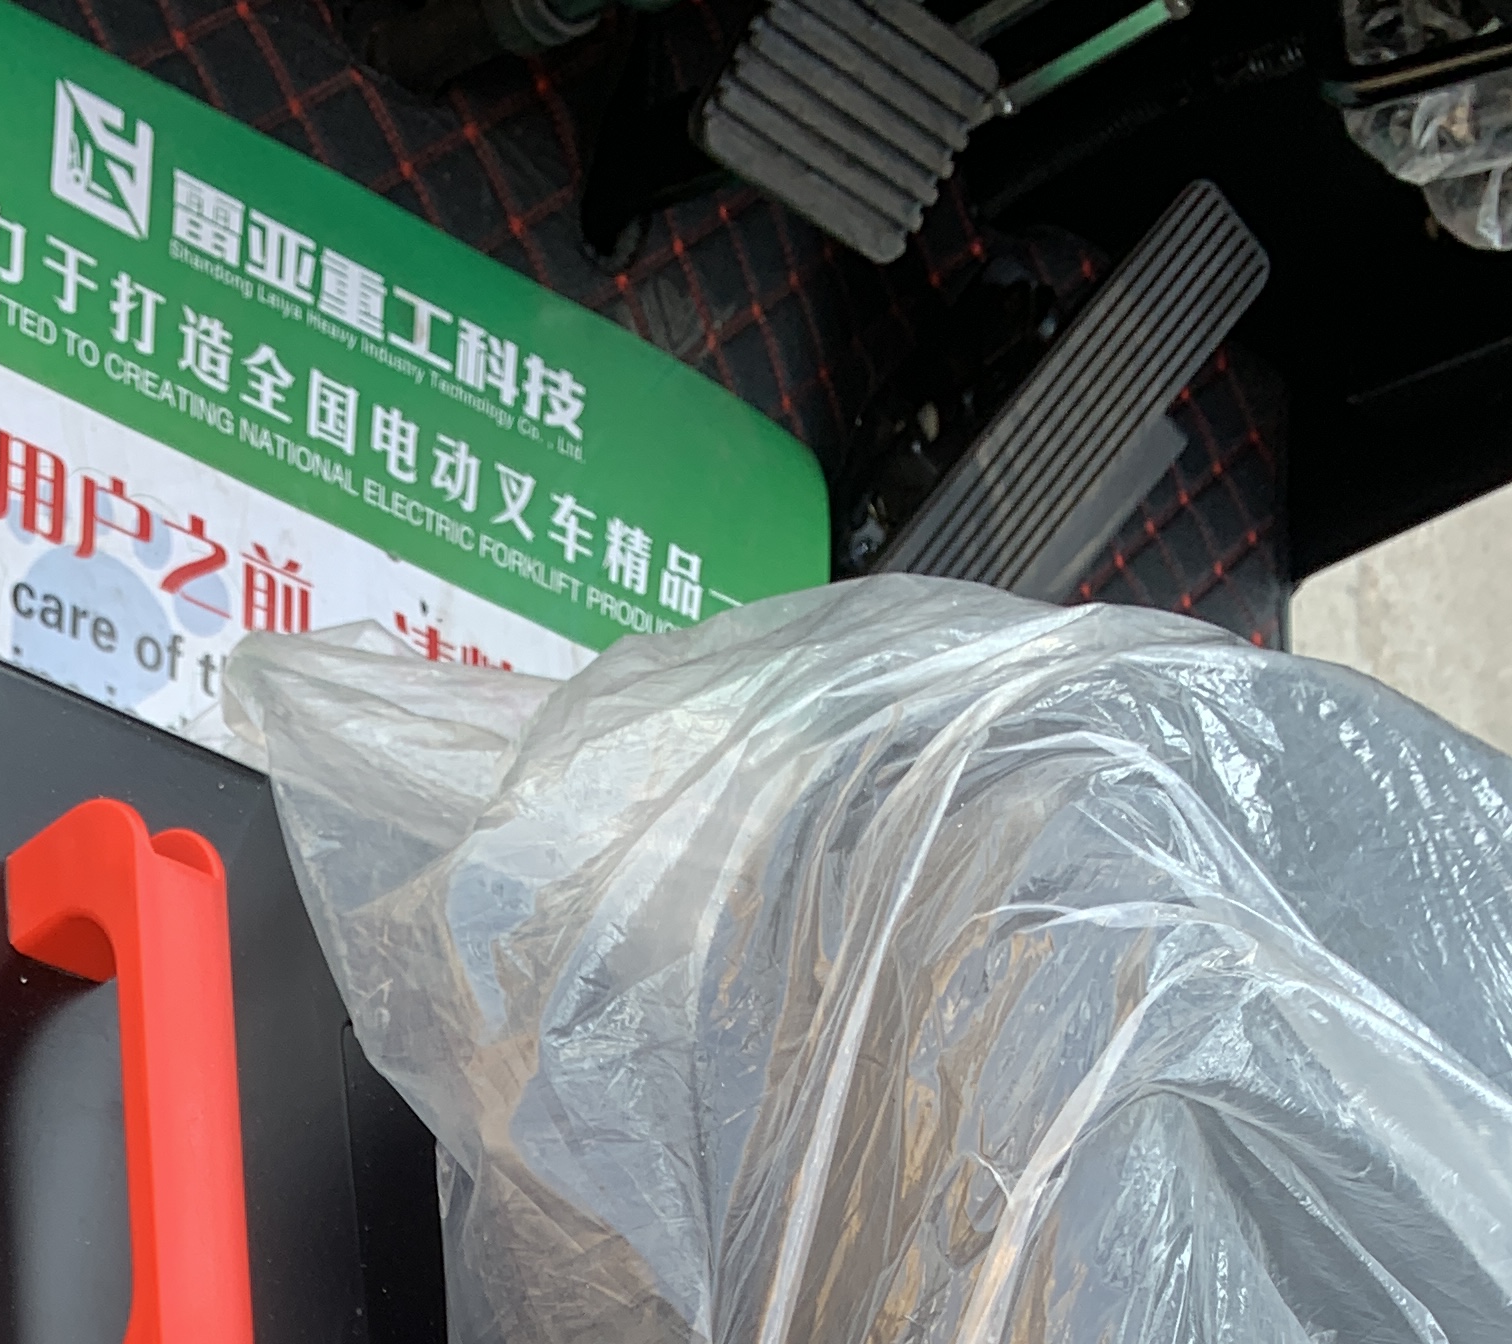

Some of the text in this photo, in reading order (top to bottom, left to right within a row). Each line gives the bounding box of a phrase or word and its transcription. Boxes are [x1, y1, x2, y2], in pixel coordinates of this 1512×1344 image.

[169, 237, 254, 300] Shandong
[257, 282, 303, 322] Laiya
[306, 310, 357, 352] Heavy
[361, 334, 426, 385] Industry
[430, 365, 516, 430] Technology
[172, 168, 587, 440] 雷亚重工科技
[62, 326, 100, 368] TO
[104, 352, 235, 436] CREATING
[238, 416, 359, 497] NATIONAL
[363, 477, 475, 552] ELECTRIC
[479, 534, 584, 603] FORKLIFT
[11, 579, 119, 653] care
[134, 630, 186, 681] of
